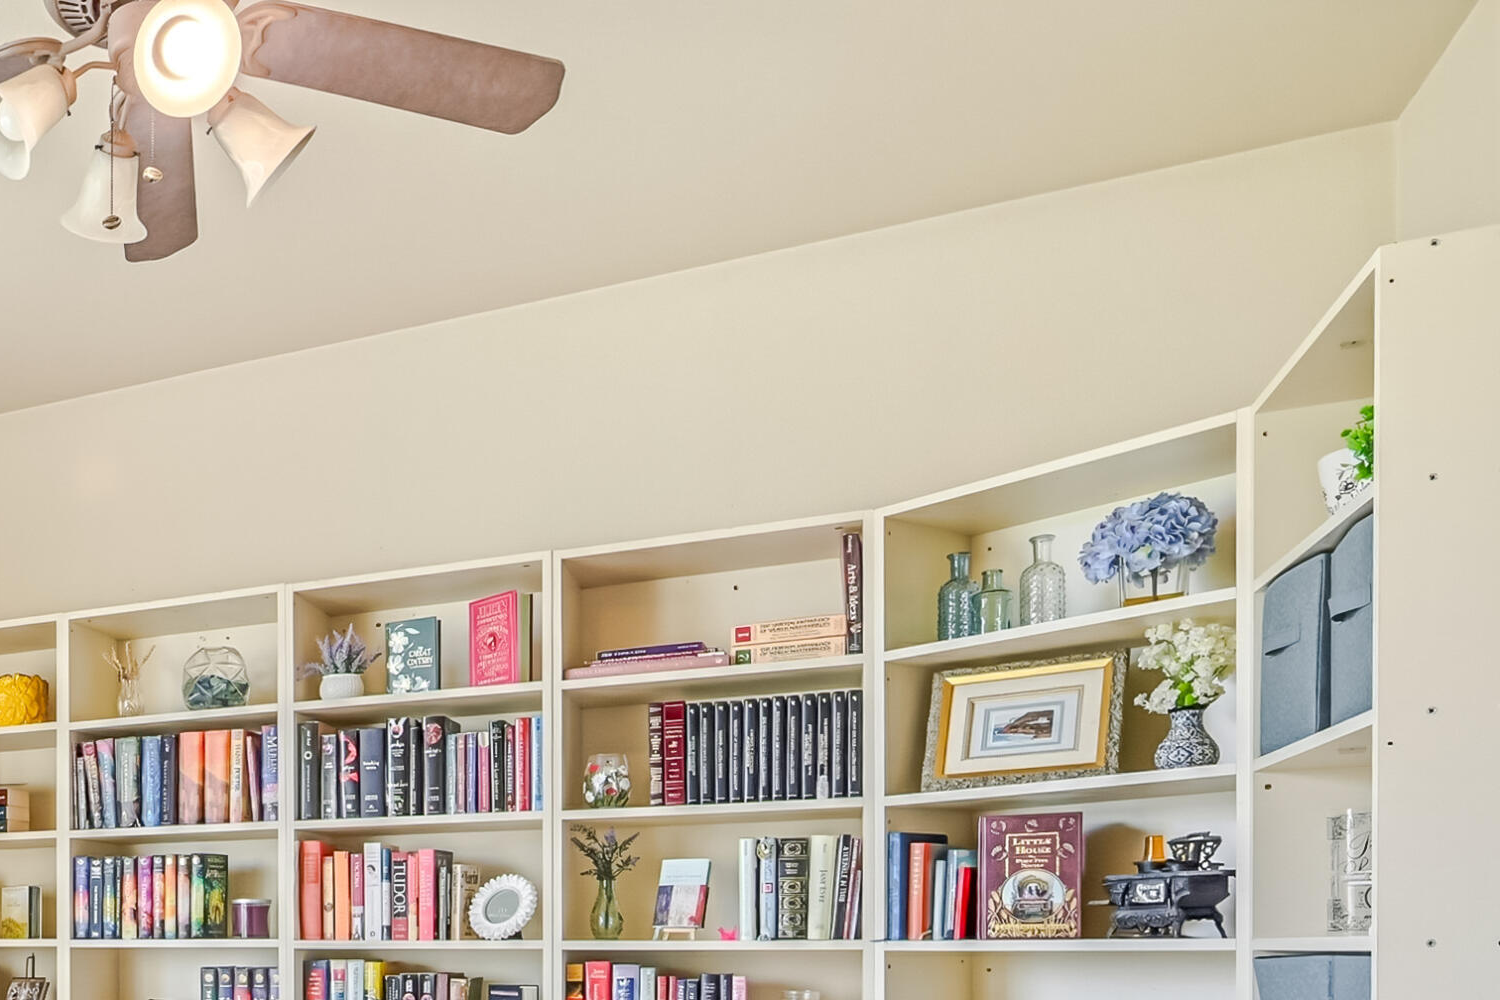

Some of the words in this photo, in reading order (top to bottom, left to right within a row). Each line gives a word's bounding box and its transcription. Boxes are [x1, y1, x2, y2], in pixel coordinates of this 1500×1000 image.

[846, 563, 857, 584] Arts
[848, 585, 857, 593] &
[1012, 837, 1052, 847] LITTLE
[1015, 846, 1052, 855] HOUSE
[393, 862, 406, 914] TUDOR
